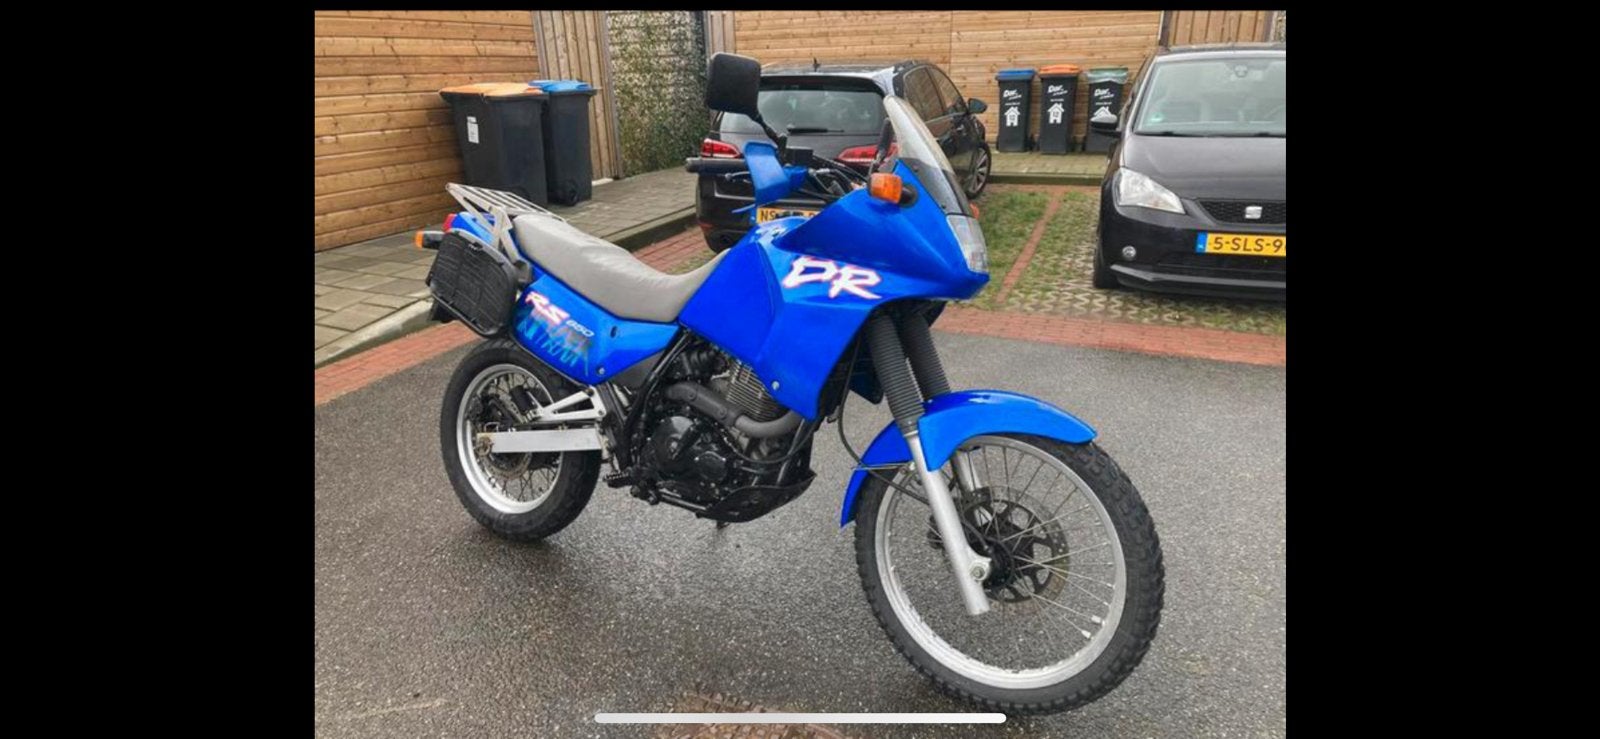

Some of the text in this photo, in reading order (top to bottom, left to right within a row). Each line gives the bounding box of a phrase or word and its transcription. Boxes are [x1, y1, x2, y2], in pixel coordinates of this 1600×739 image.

[1213, 236, 1286, 253] 5-SLS-9
[782, 255, 883, 299] DR
[525, 291, 570, 326] RS
